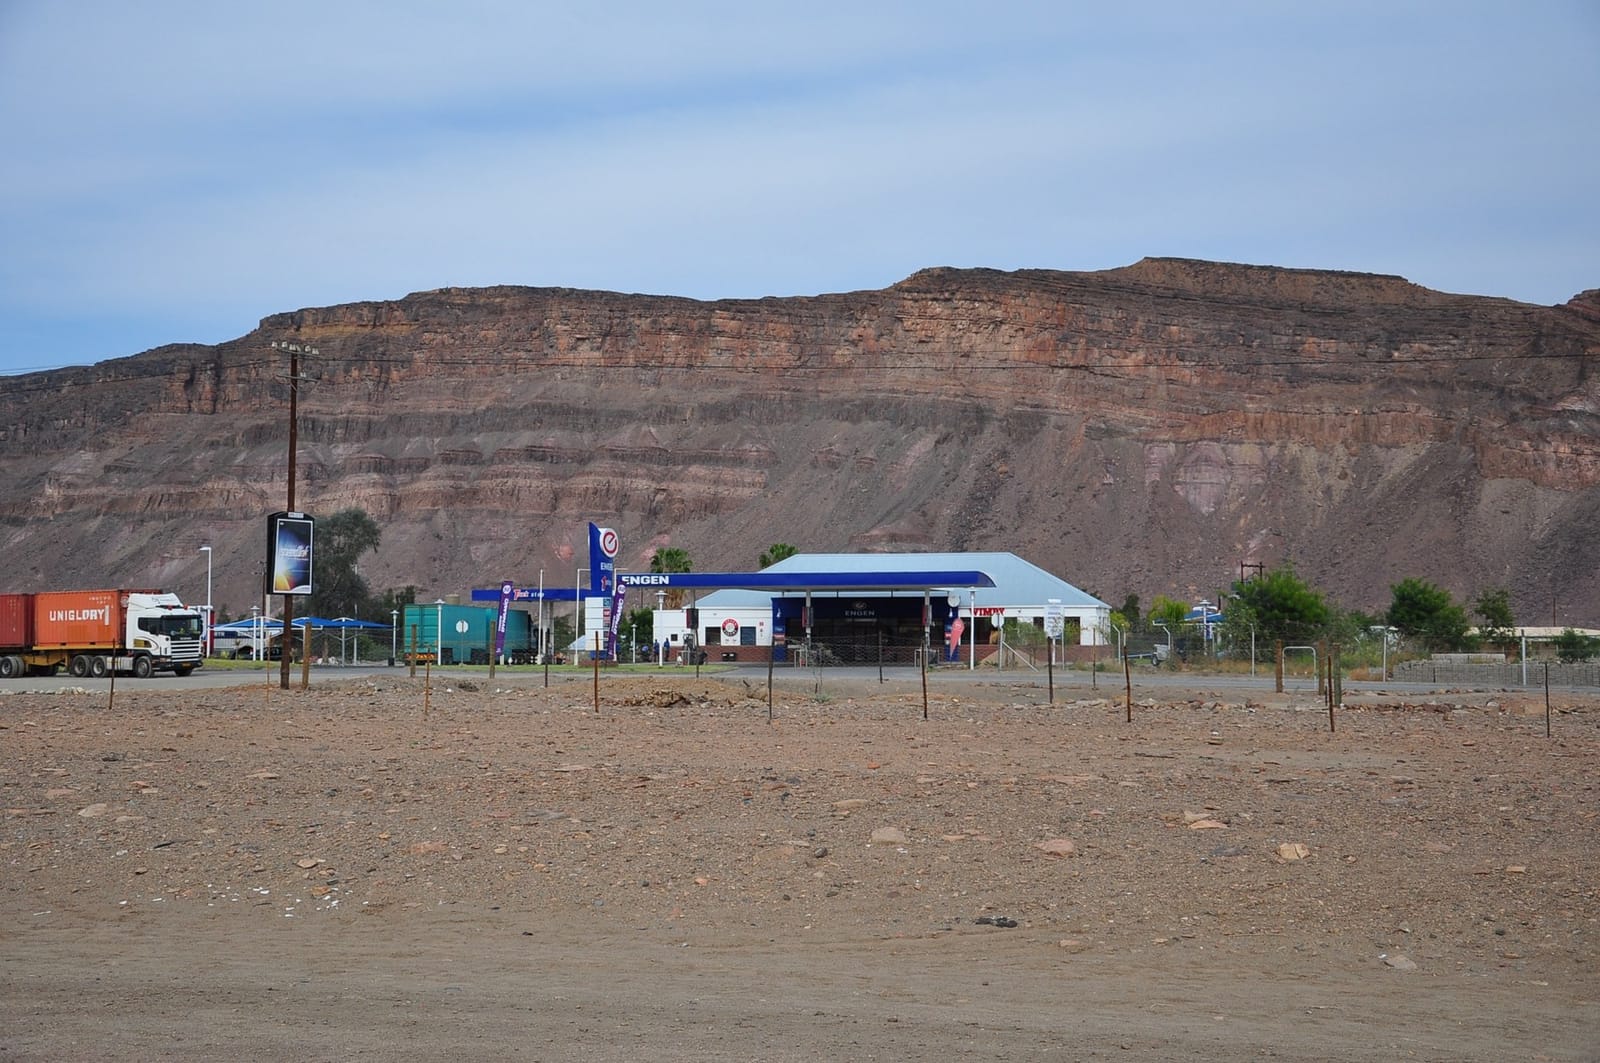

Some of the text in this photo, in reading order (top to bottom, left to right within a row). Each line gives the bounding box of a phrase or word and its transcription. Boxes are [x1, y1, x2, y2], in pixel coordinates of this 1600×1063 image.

[622, 576, 669, 585] ENGEN
[49, 609, 105, 622] UNIGLORY
[969, 607, 1006, 616] WIMPY
